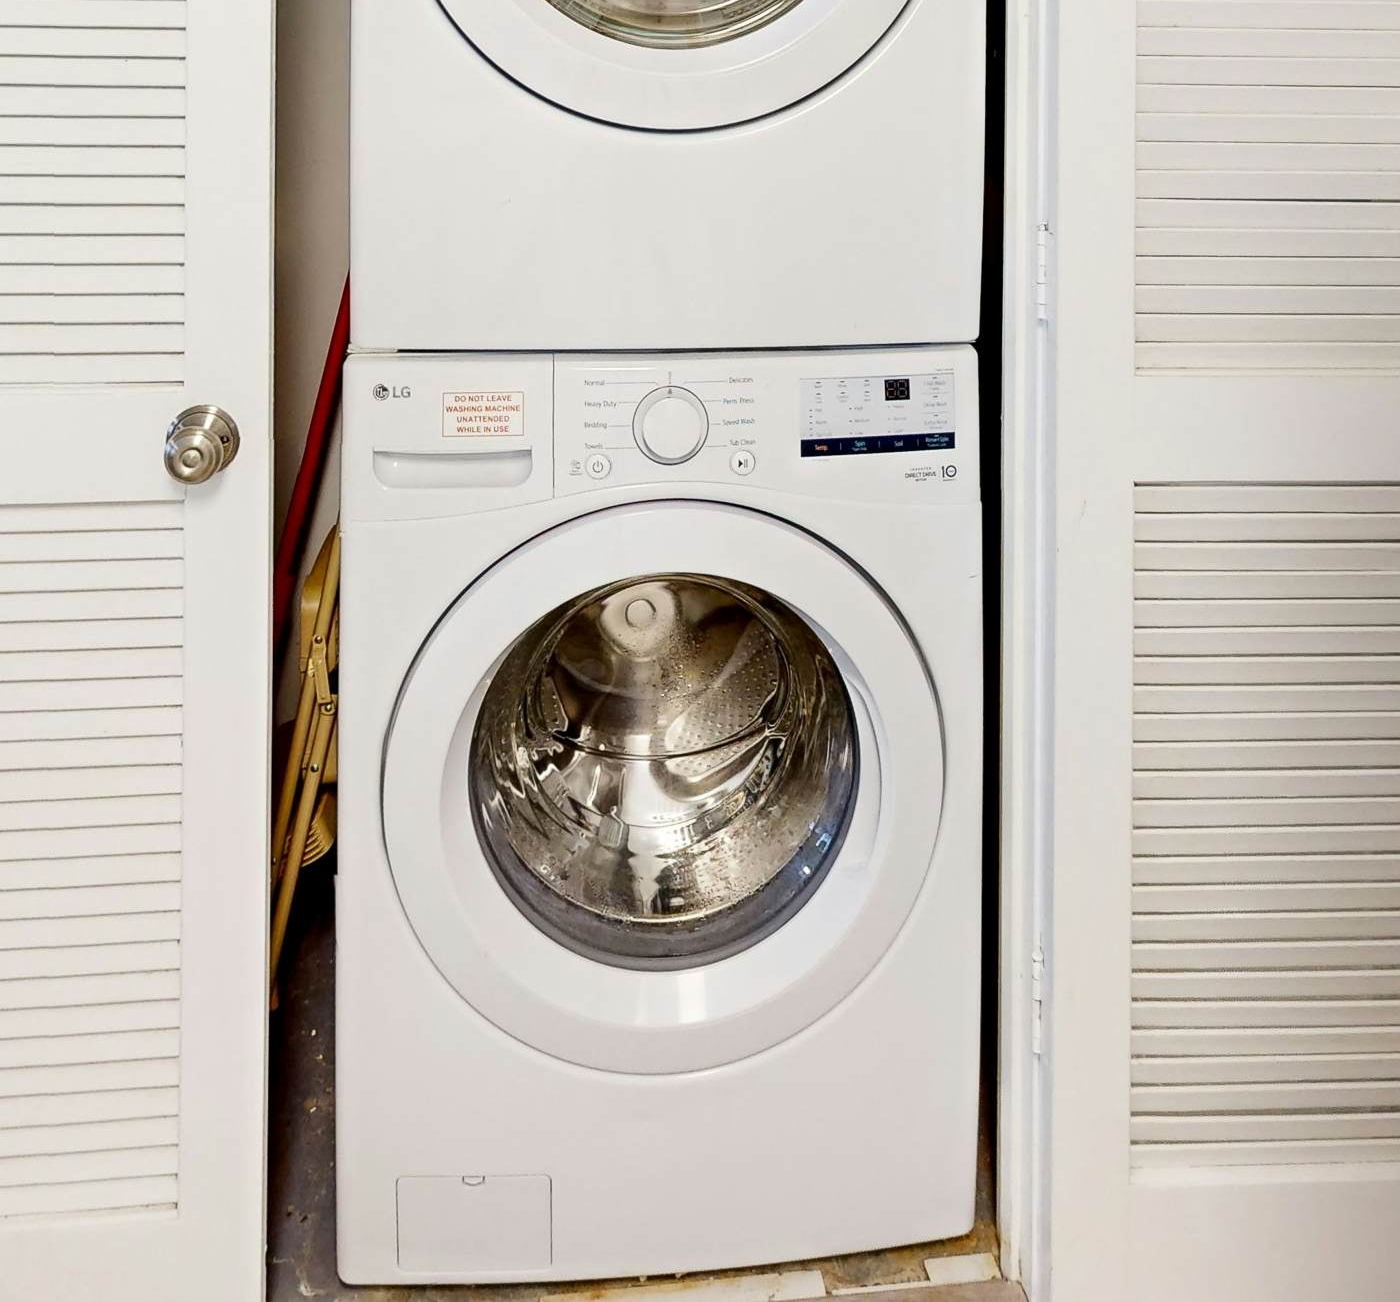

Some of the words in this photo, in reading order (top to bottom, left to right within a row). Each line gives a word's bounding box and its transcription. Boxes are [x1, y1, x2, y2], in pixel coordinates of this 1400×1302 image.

[392, 386, 411, 399] LG
[454, 395, 466, 403] DO
[469, 394, 485, 402] NOT
[486, 394, 513, 402] LEAVE
[445, 405, 483, 413] WASHING
[484, 404, 521, 412] MACHINE
[603, 400, 617, 408] Duty
[456, 415, 510, 424] UNATTENDED
[456, 425, 481, 434] WHILE
[483, 425, 491, 433] IN
[493, 425, 509, 433] USE
